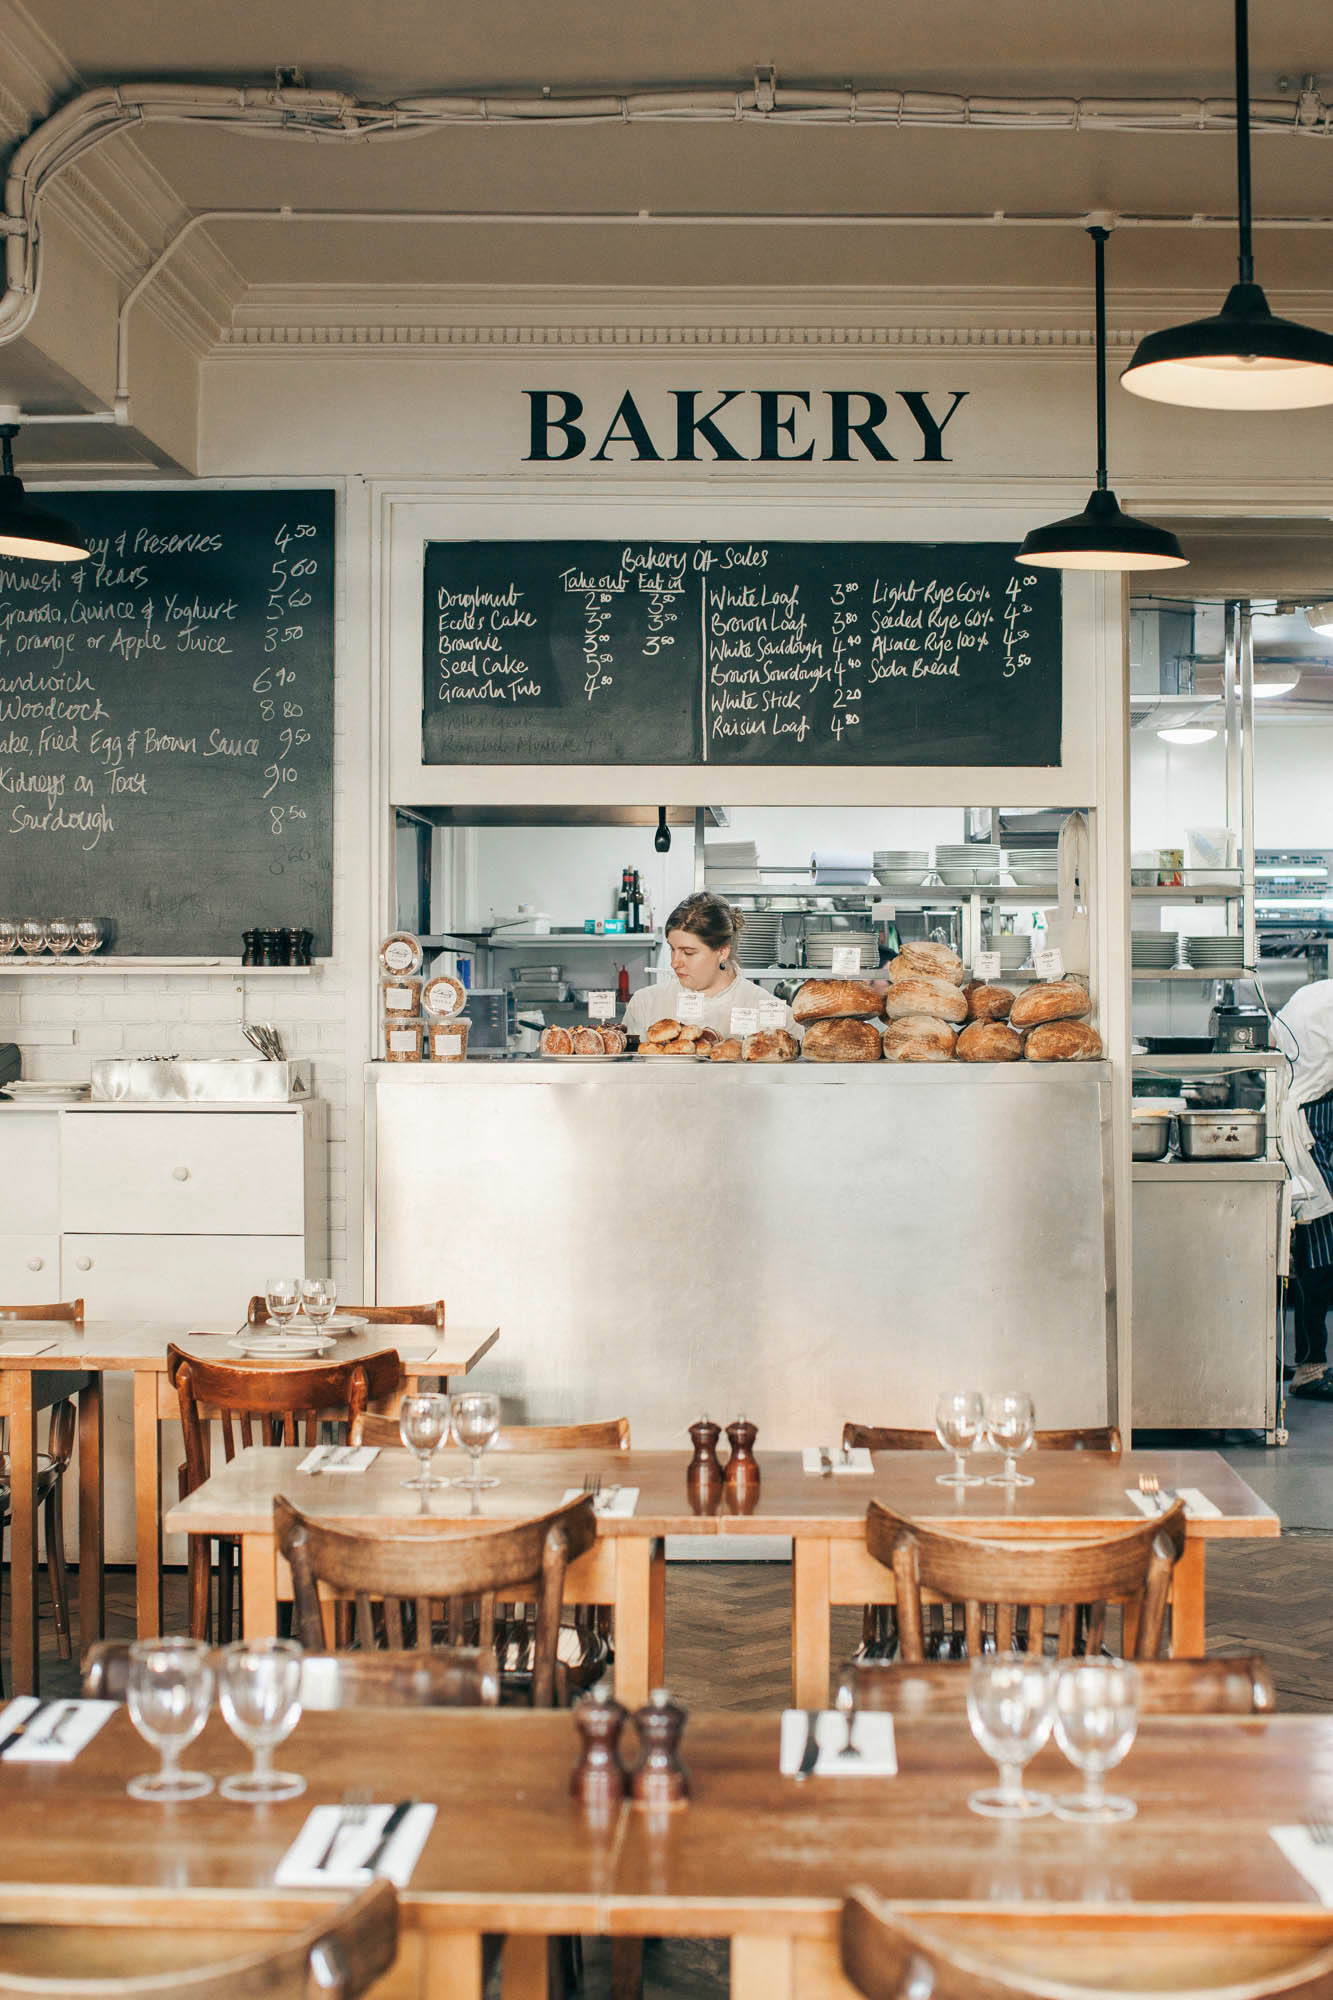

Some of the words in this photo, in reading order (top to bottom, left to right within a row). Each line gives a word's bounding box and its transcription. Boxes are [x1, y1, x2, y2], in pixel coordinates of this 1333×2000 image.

[520, 389, 970, 462] BAKERY
[134, 528, 223, 554] Preserves
[621, 547, 687, 580] Bakery
[693, 549, 719, 572] Off
[720, 545, 769, 569] Sales
[0, 568, 61, 593] Muesli
[96, 565, 149, 590] Pears
[639, 573, 665, 590] Eat
[70, 599, 136, 625] Quince
[164, 593, 239, 629] Yoghurt
[438, 582, 525, 619] Doughnut
[710, 584, 759, 611] White
[761, 584, 800, 619] Loaf
[872, 578, 925, 613] Light
[924, 579, 954, 610] Rye
[956, 581, 991, 603] 60%
[439, 611, 485, 633] Eccles
[490, 608, 537, 631] Cake
[711, 612, 767, 637] Brown
[771, 607, 807, 641] Loaf
[870, 608, 923, 634] Seeded
[928, 606, 961, 639] Rye
[964, 608, 995, 627] 60%
[86, 634, 106, 649] or
[109, 626, 167, 661] Apple
[177, 624, 233, 654] Juice
[438, 632, 503, 655] Brownie
[710, 639, 755, 662] White
[756, 635, 823, 664] Sourdough
[871, 634, 920, 661] Alsace
[924, 631, 954, 661] Rye
[440, 654, 480, 680] Seed
[482, 653, 529, 676] Cake
[711, 663, 760, 687] Brown
[759, 660, 833, 694] Sourdough
[868, 658, 908, 684] Soda
[911, 655, 960, 679] Bread
[438, 679, 507, 703] Granola
[507, 677, 542, 702] Tub
[711, 689, 759, 713] White
[762, 689, 802, 713] Stick
[0, 695, 111, 721] Woodcock
[712, 715, 767, 740] Raisin
[773, 712, 811, 743] Loaf
[38, 724, 80, 757] Fried
[90, 728, 122, 766] Egg
[145, 727, 197, 754] Brown
[203, 728, 260, 757] Sauce
[0, 766, 66, 812] Kidneys
[75, 774, 94, 797] on
[104, 766, 148, 794] Toast
[9, 803, 115, 851] Sourdough
